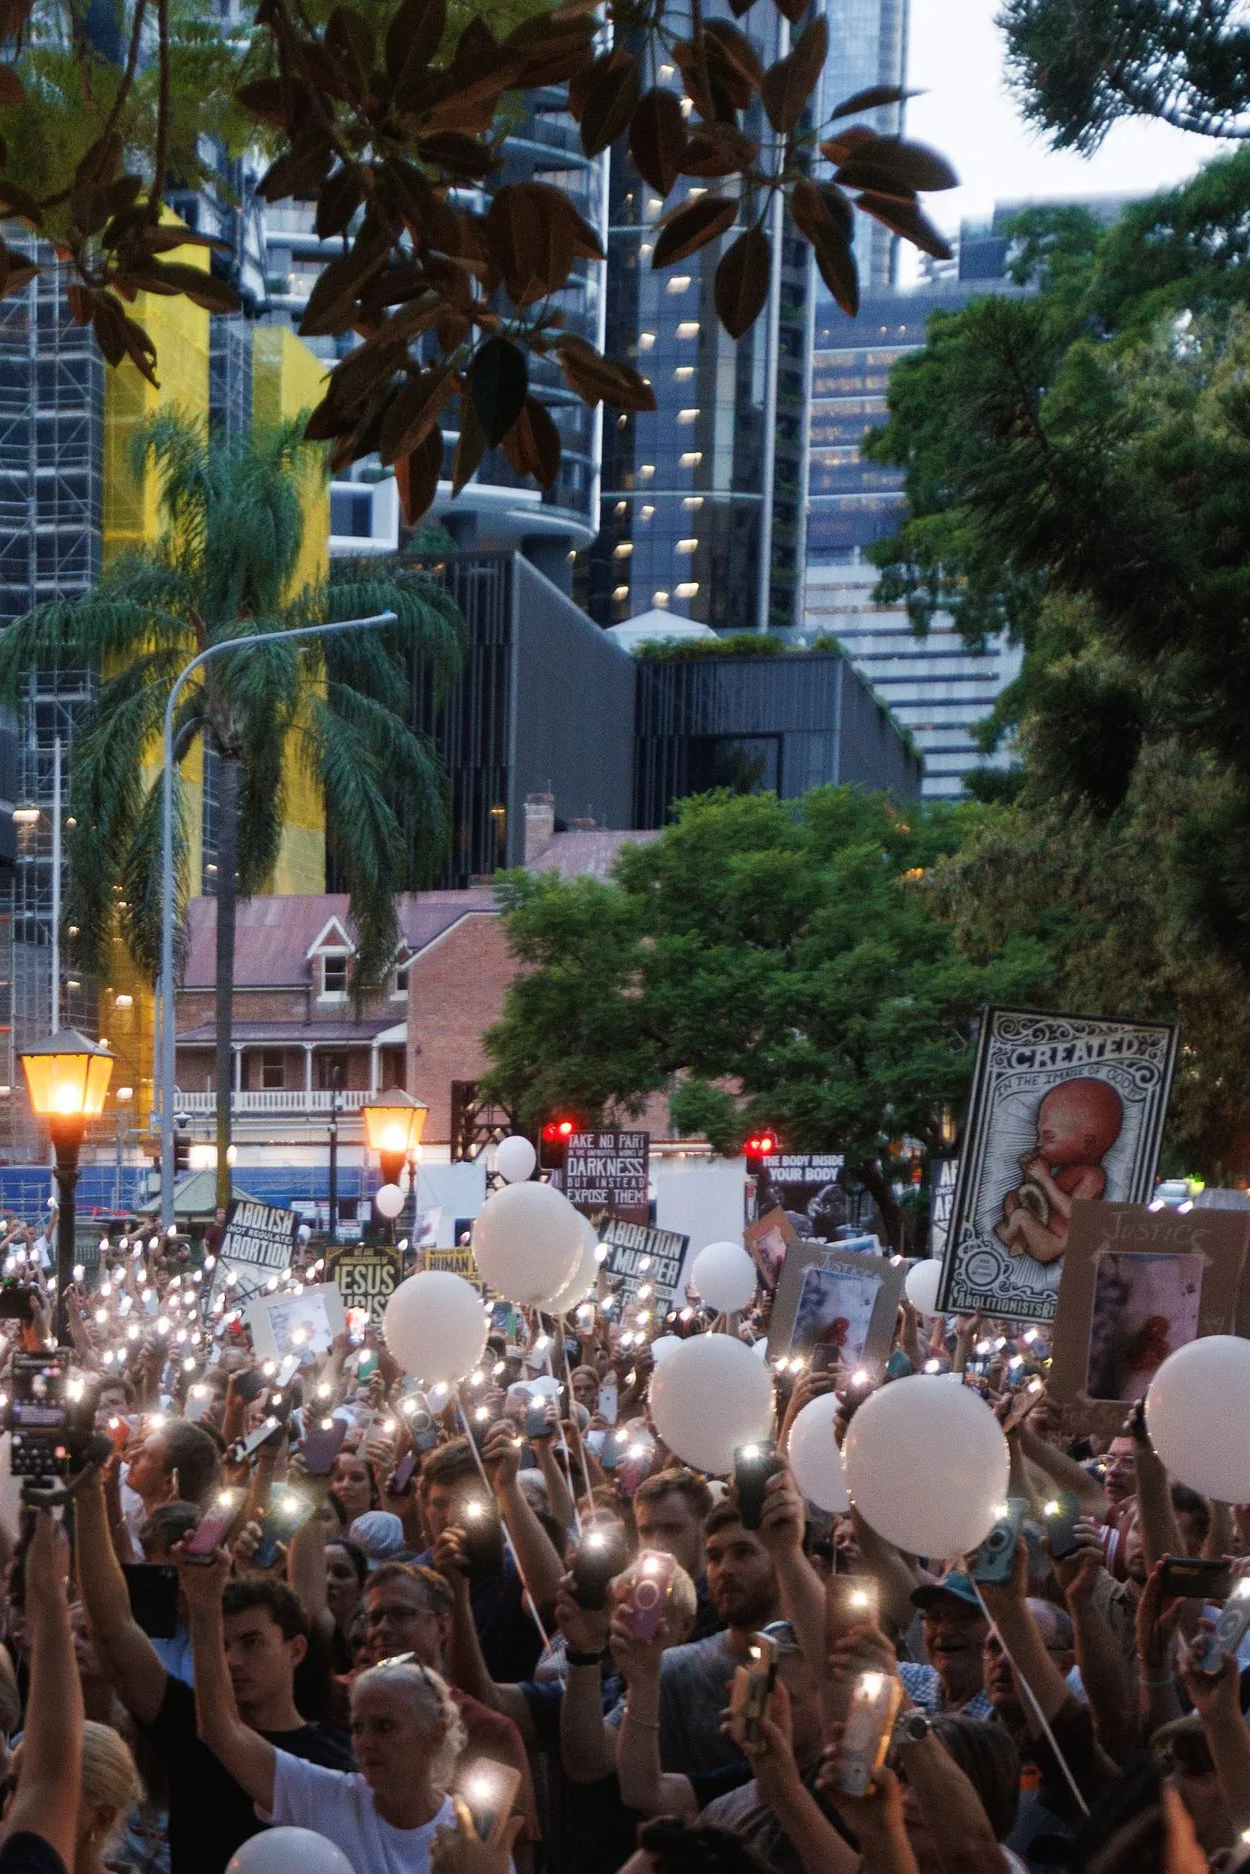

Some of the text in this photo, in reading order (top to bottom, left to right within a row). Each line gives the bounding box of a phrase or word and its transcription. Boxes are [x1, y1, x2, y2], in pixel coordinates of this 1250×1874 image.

[1010, 1037, 1140, 1068] CREATED
[1017, 1076, 1039, 1086] THE
[568, 1134, 645, 1148] TAKE NO PART
[781, 1155, 810, 1166] BODY
[811, 1155, 845, 1166] INSIDE
[769, 1167, 839, 1180] YOUR BODY
[567, 1177, 645, 1187] BUT INSTEAD
[566, 1189, 609, 1203] EXPOSE
[232, 1201, 295, 1234] ABOLISH
[603, 1219, 684, 1259] ABORTION
[220, 1233, 293, 1268] ABORTION
